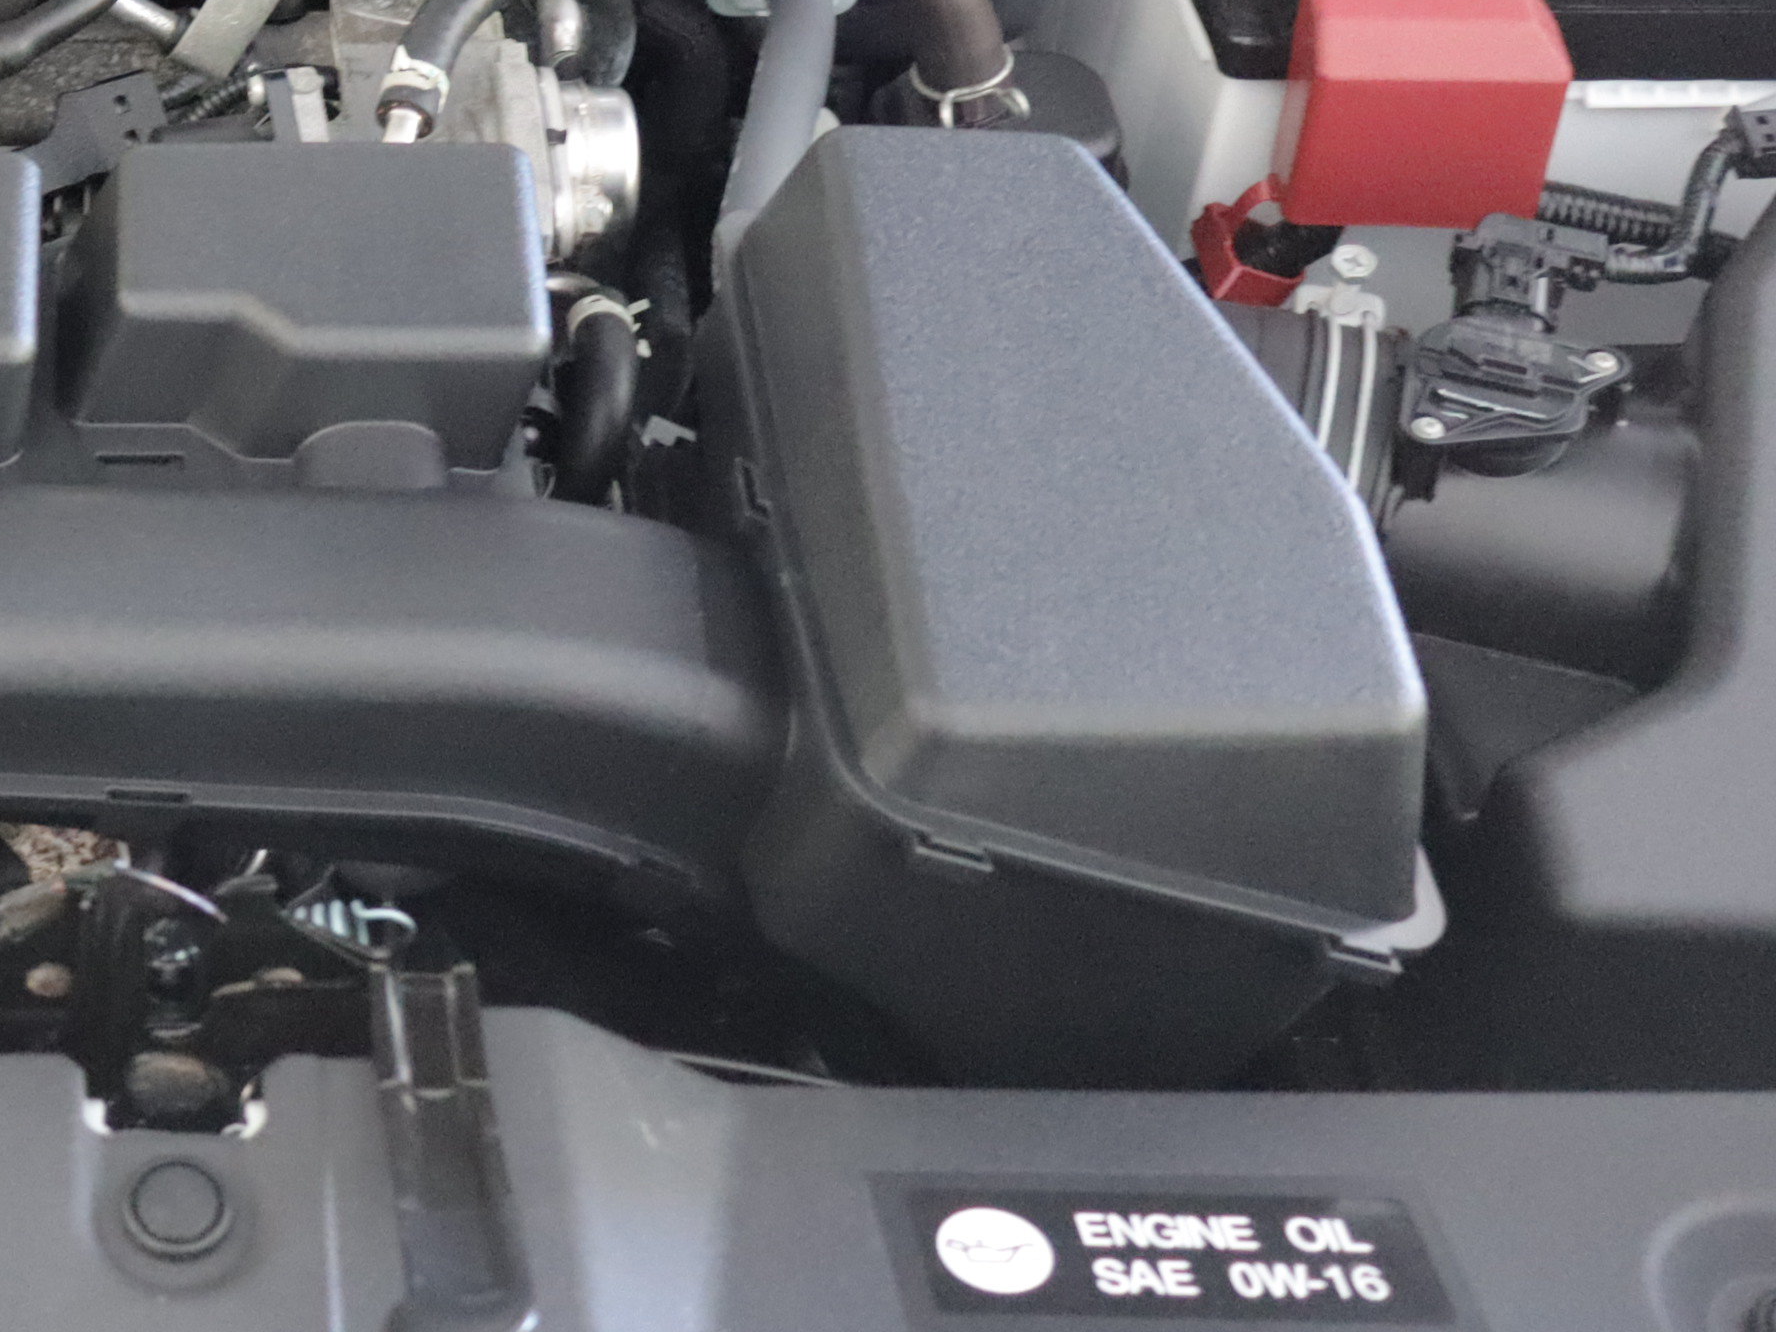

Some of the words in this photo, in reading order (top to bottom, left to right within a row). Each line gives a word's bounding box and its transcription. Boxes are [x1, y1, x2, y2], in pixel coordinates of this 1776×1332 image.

[1074, 1211, 1261, 1252] ENGINE
[1284, 1215, 1376, 1255] OIL
[1091, 1257, 1202, 1297] SAE
[1228, 1261, 1393, 1303] 0W-16
